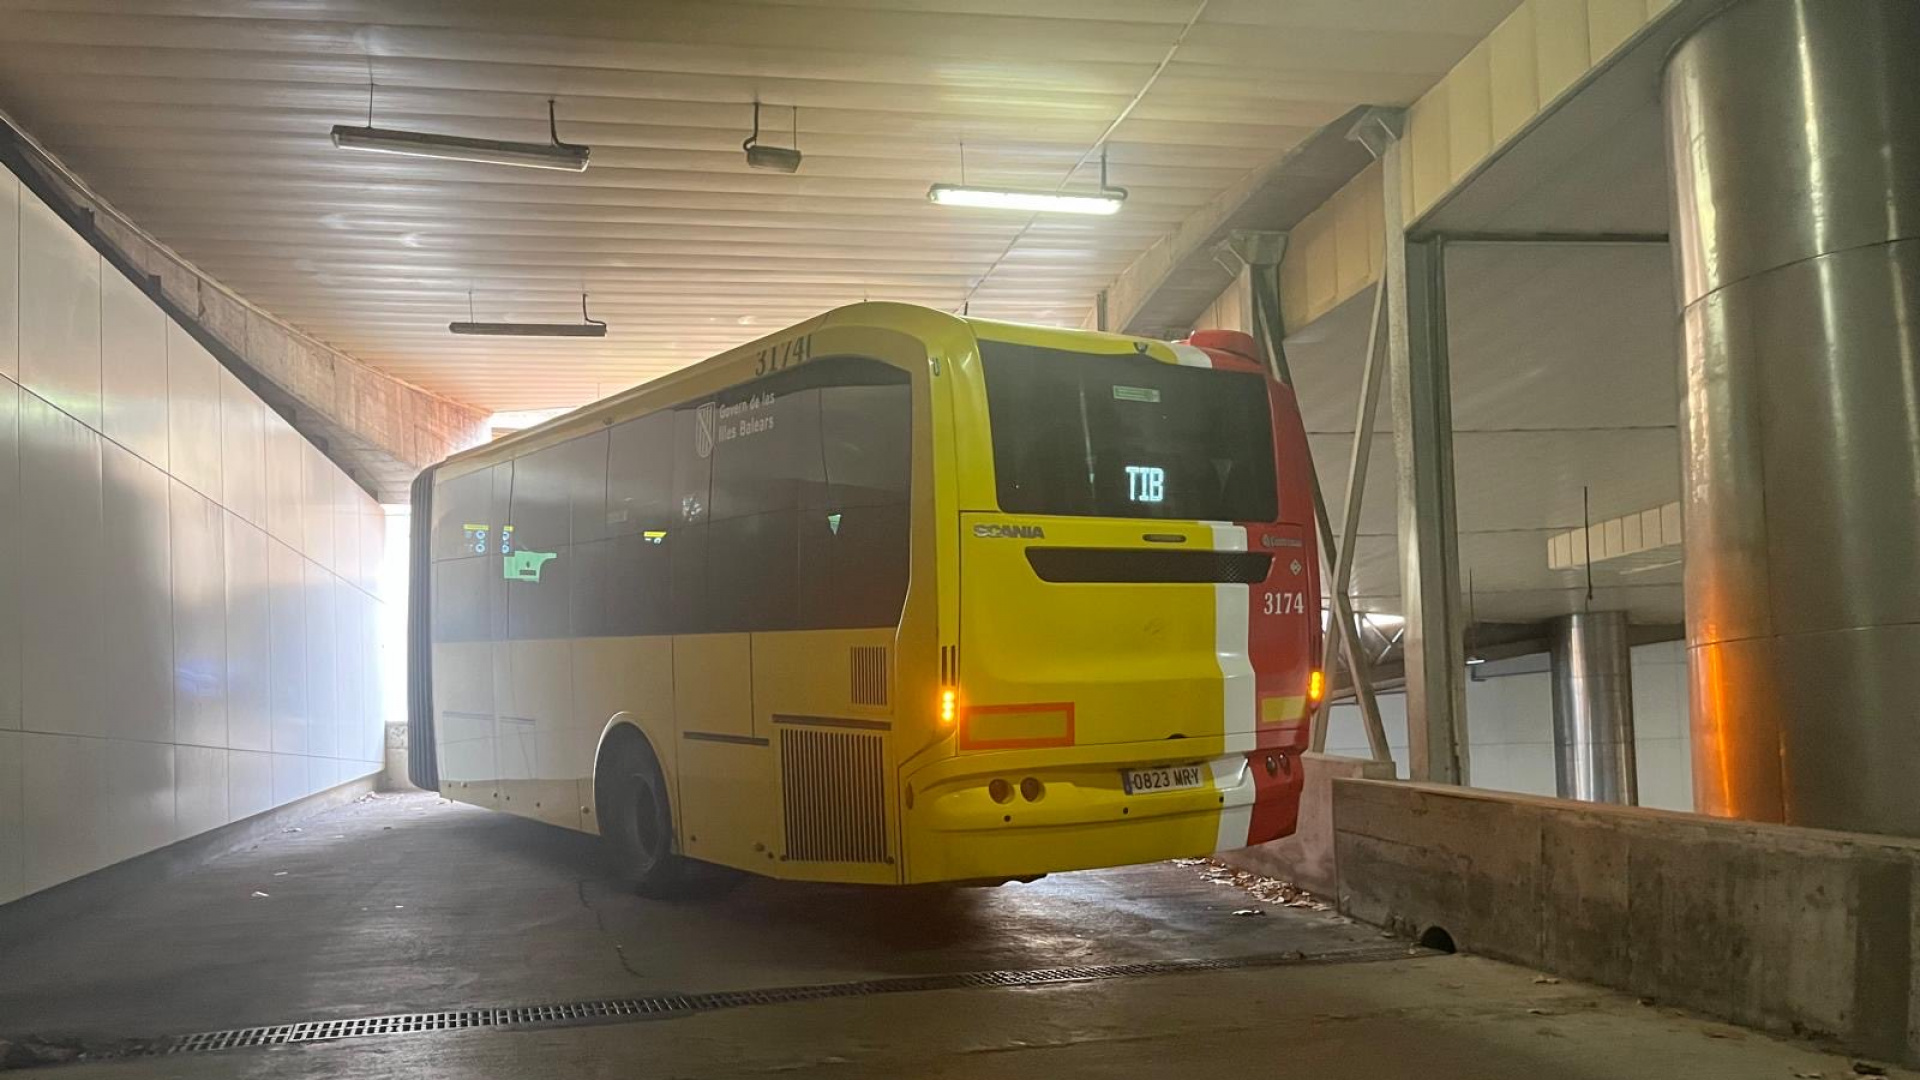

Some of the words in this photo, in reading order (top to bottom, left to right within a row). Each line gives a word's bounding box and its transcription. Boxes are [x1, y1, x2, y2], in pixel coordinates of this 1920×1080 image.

[720, 403, 748, 419] Govern
[749, 394, 760, 410] de
[762, 390, 775, 405] las
[719, 425, 737, 442] Illes
[740, 415, 774, 437] Balears
[1125, 466, 1164, 502] TIB
[973, 524, 1046, 540] SCANIA
[1263, 592, 1304, 615] 3174
[1133, 771, 1171, 790] 0823
[1173, 767, 1199, 787] MRY
